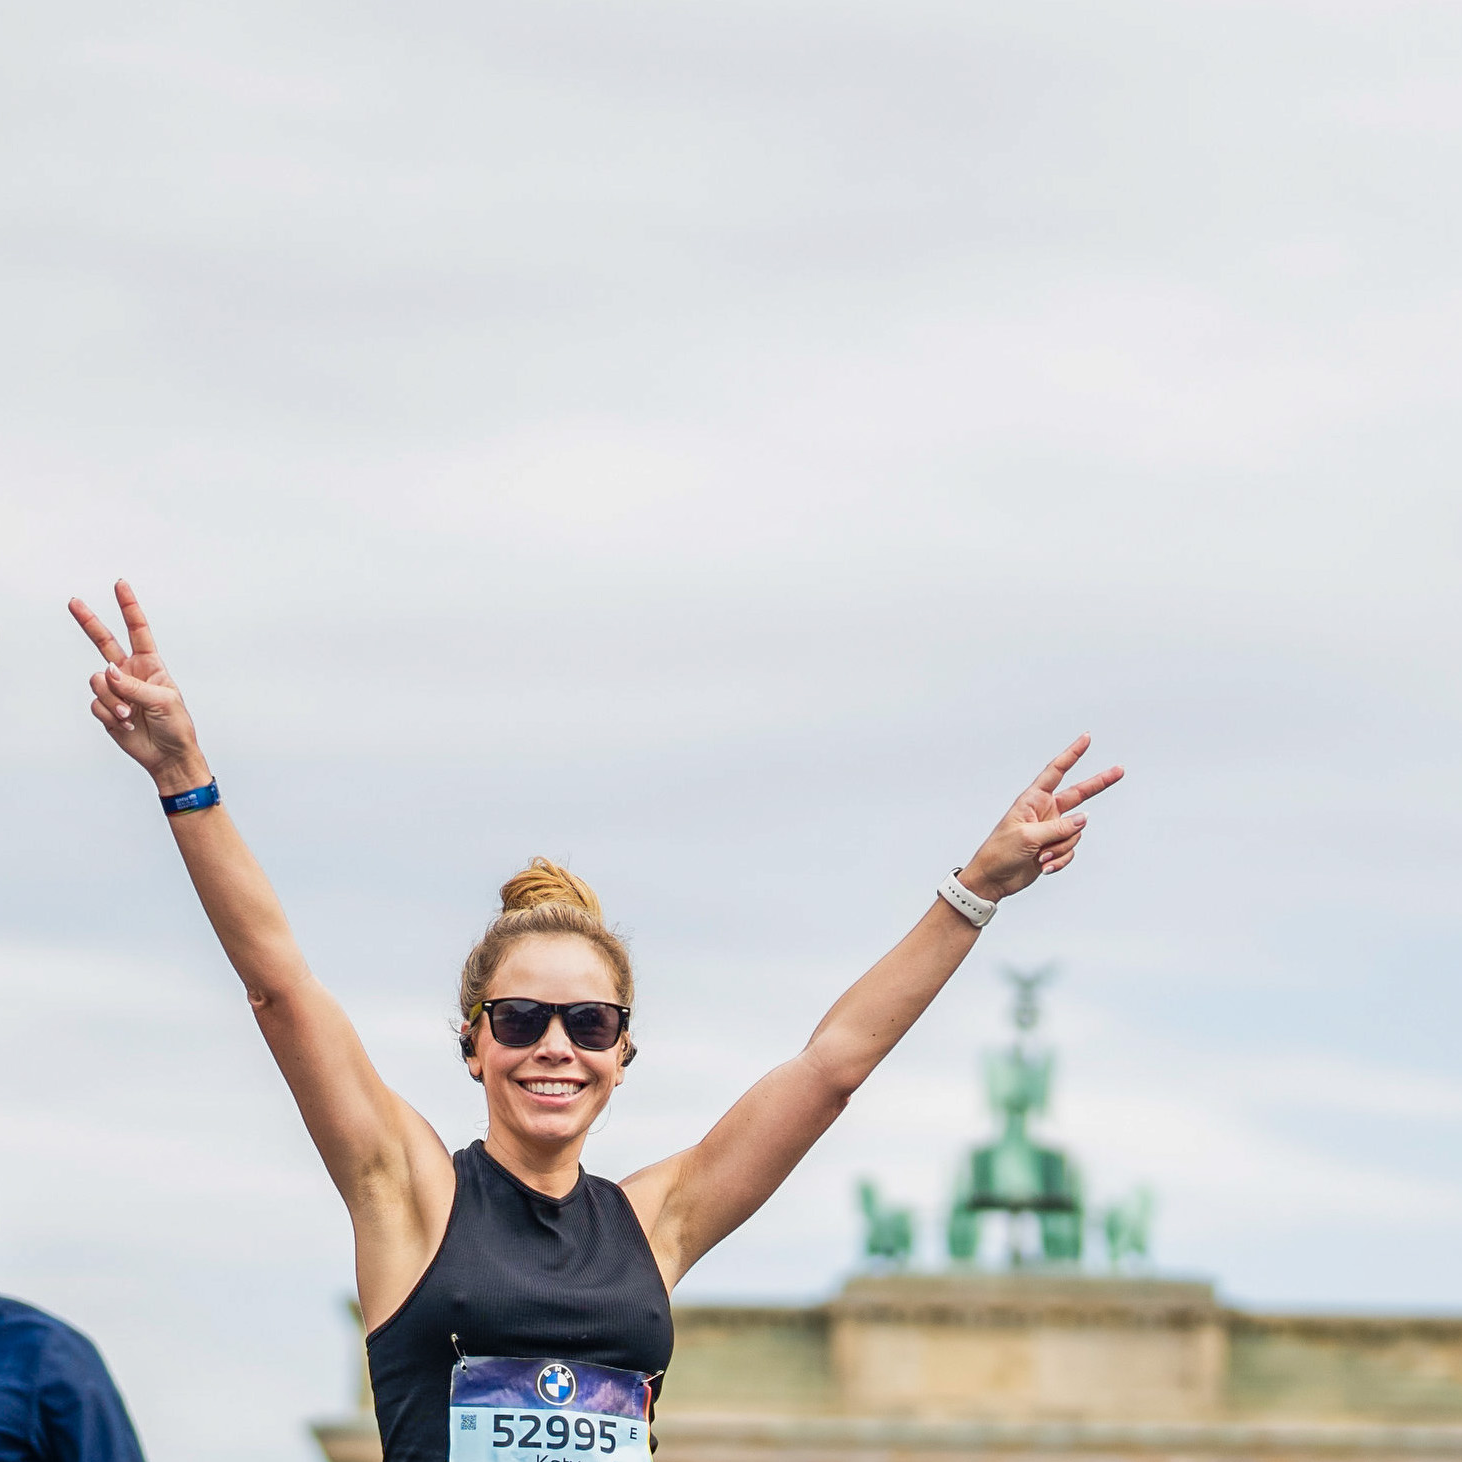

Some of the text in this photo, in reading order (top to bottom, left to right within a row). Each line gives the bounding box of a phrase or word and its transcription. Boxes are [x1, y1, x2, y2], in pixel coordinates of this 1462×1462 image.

[544, 1366, 573, 1380] BMW
[492, 1414, 638, 1454] 52995 E
